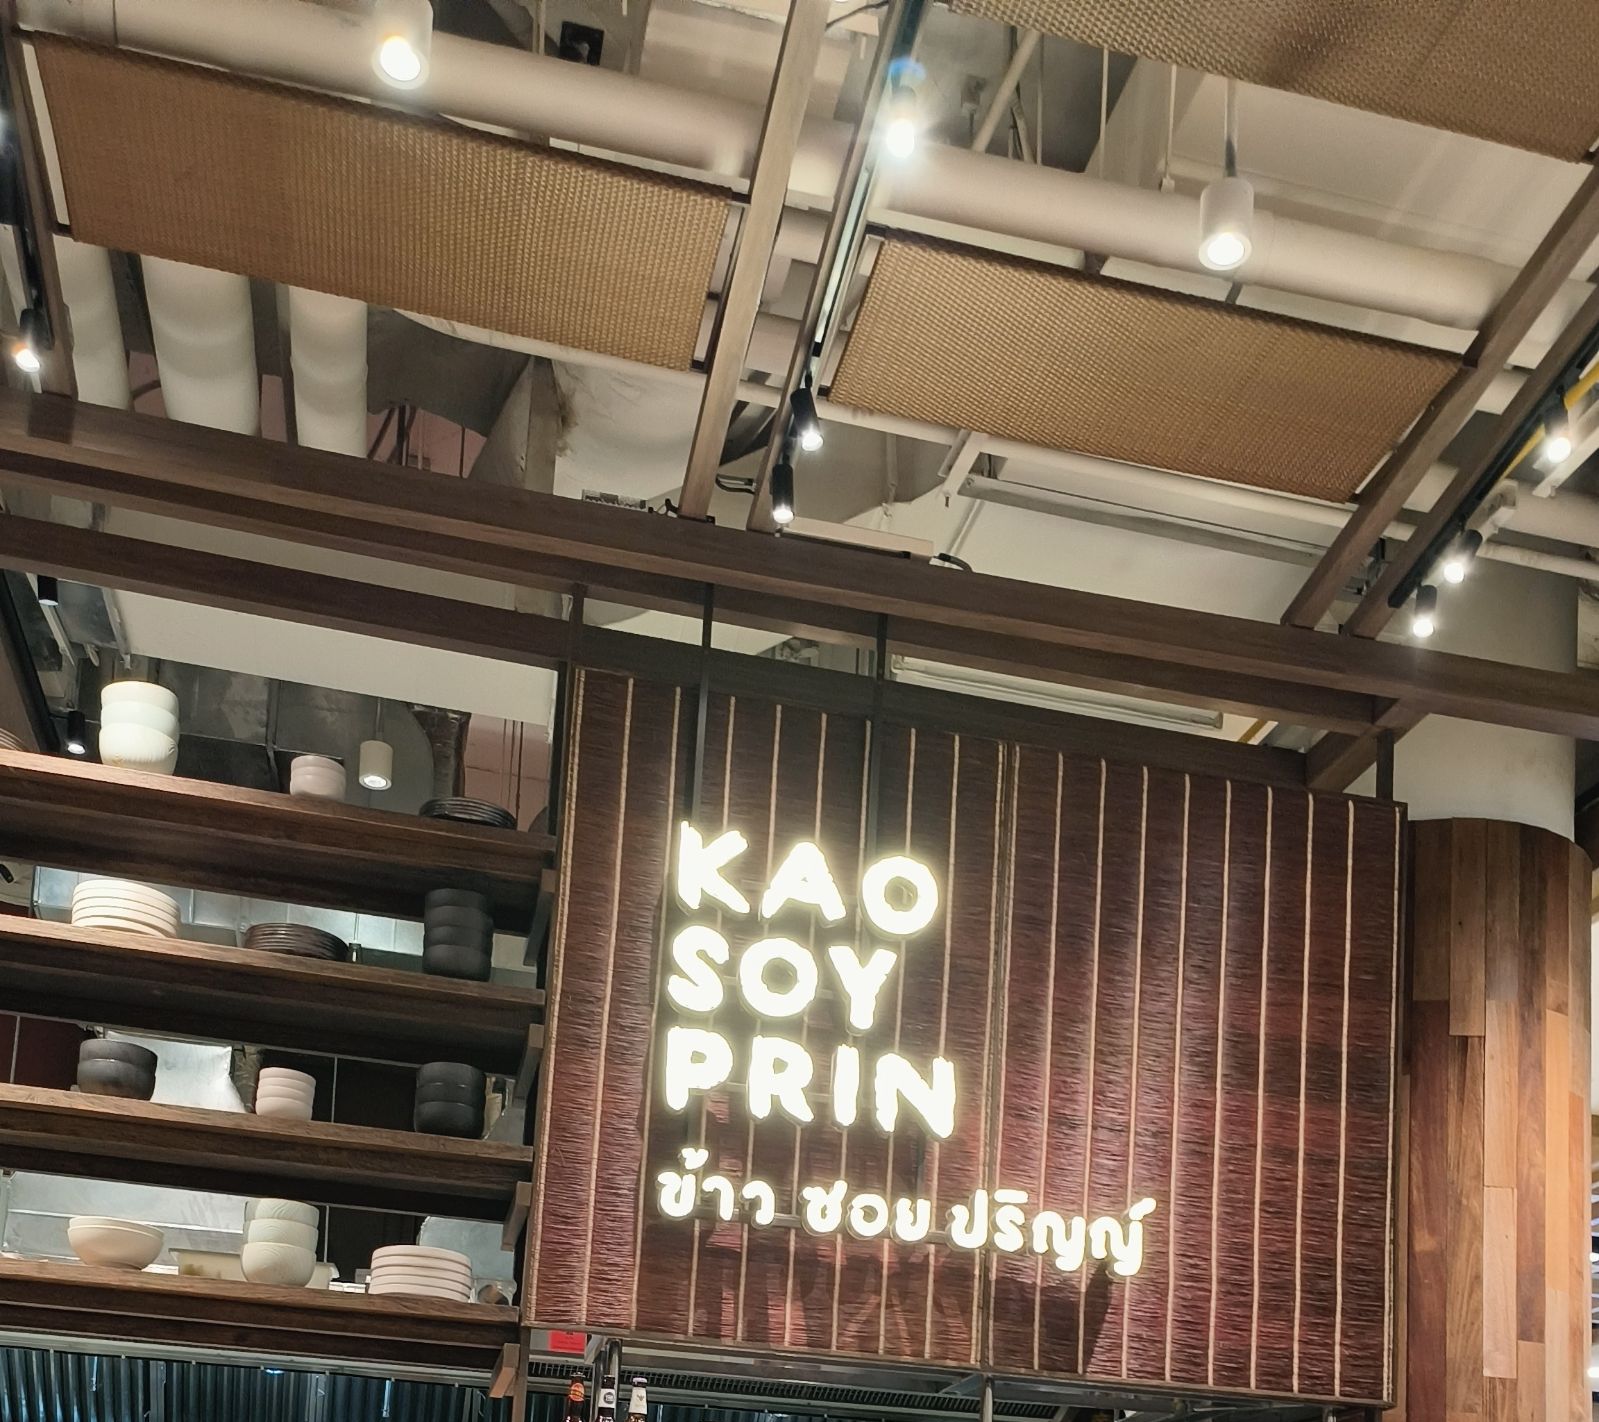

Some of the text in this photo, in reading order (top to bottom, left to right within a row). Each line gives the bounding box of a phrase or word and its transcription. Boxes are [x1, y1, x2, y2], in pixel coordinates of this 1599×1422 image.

[676, 820, 939, 936] KAO
[666, 924, 898, 1031] SOY
[664, 1025, 957, 1139] PRIN
[657, 1147, 776, 1226] ข้าว
[802, 1179, 931, 1243] ซอย
